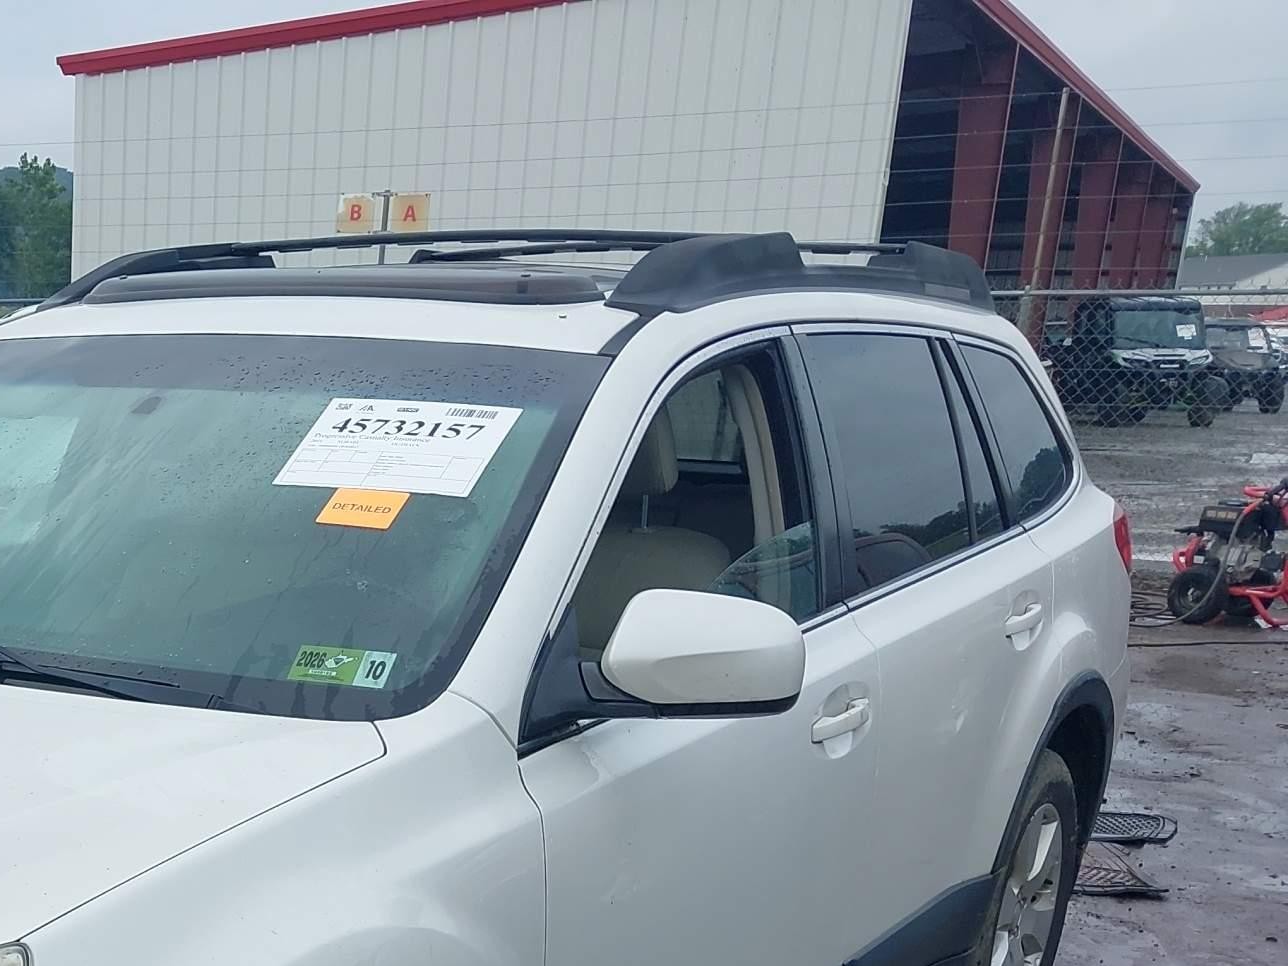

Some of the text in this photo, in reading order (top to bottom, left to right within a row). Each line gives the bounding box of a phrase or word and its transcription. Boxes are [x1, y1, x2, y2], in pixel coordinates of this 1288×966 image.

[349, 204, 362, 221] B
[403, 205, 416, 221] A
[331, 417, 486, 440] 45732157
[331, 502, 392, 515] DETAILED
[295, 650, 327, 669] 2026
[364, 659, 387, 681] 10
